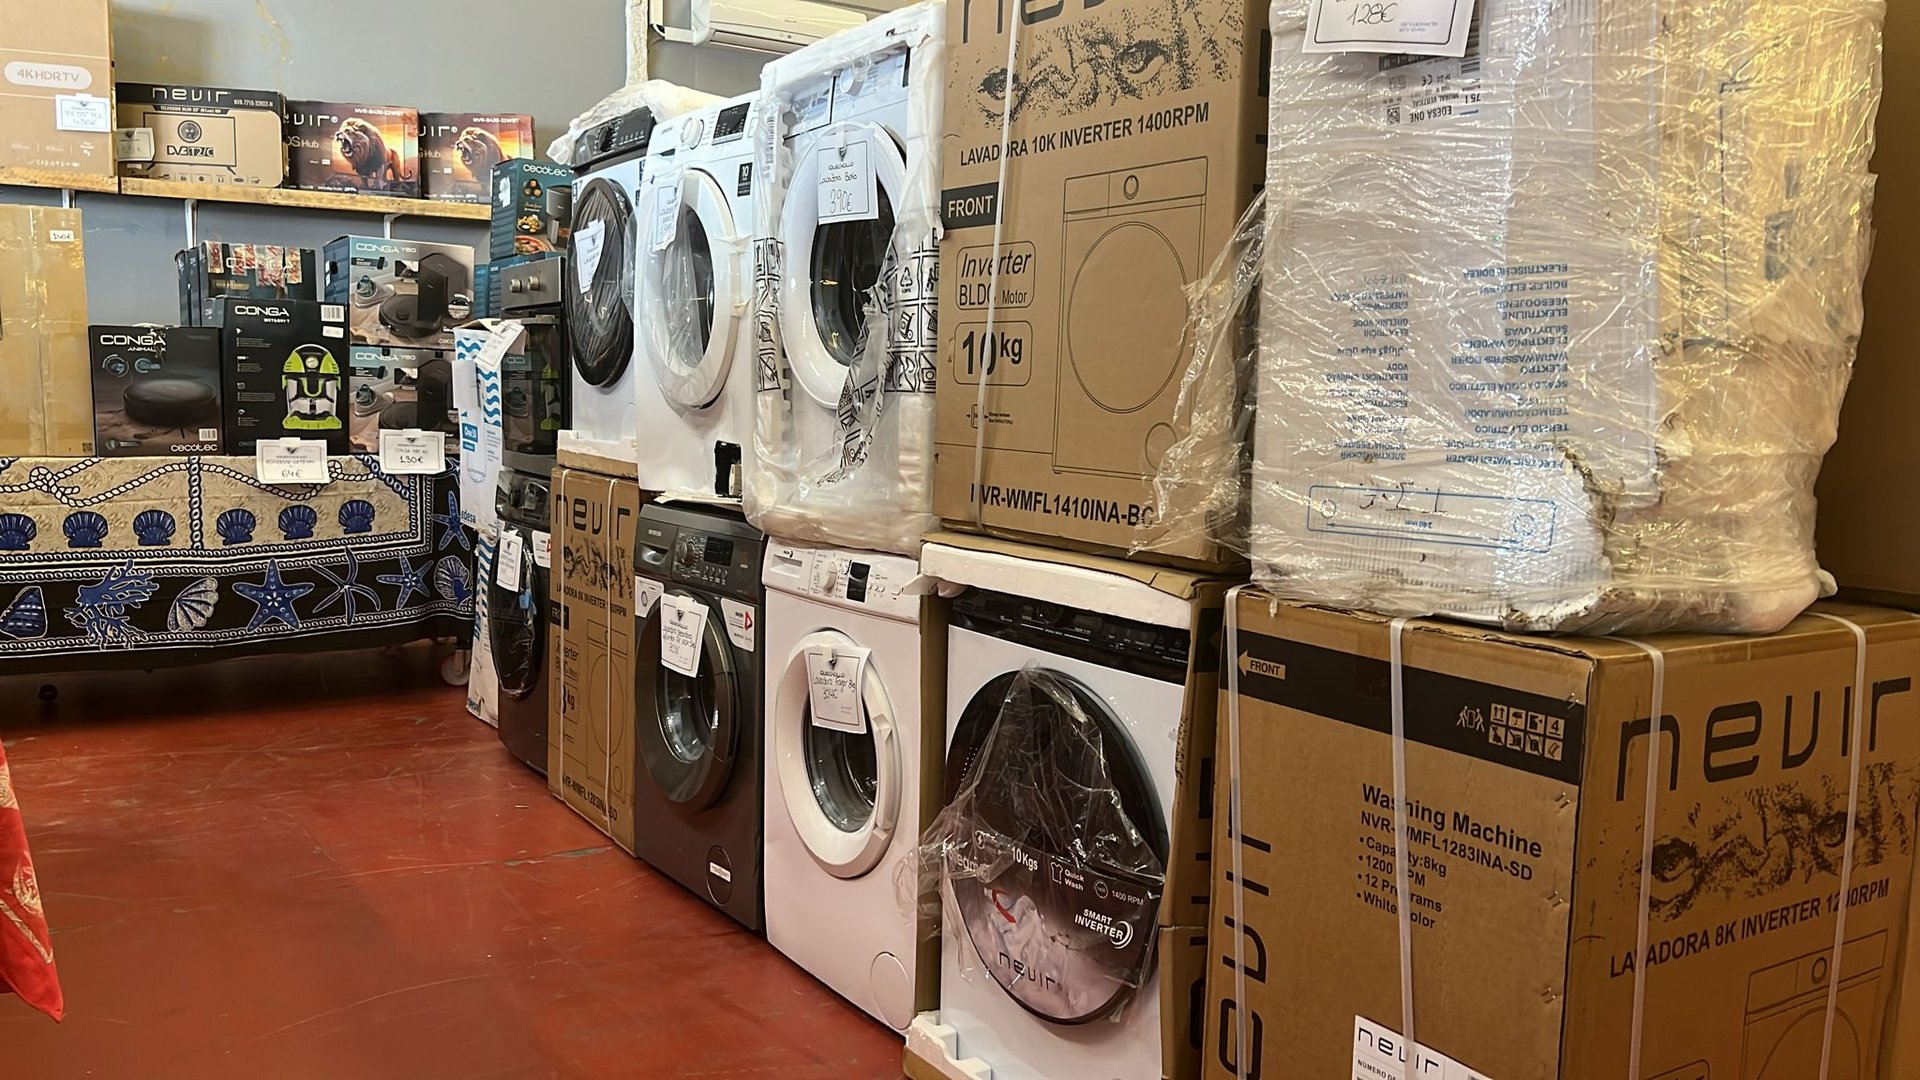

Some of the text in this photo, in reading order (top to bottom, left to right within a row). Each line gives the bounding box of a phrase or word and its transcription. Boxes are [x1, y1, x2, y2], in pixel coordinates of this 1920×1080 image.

[1347, 2, 1398, 26] 128€
[61, 72, 80, 82] TV
[152, 87, 230, 103] nevir
[1409, 105, 1452, 123] EDESA ONE
[1032, 131, 1056, 154] 10K
[1059, 118, 1133, 149] INVERTER
[1137, 102, 1210, 135] 1400RPM
[301, 141, 319, 149] Hub
[522, 163, 567, 177] cecotec
[947, 195, 994, 218] FRONT
[355, 242, 400, 254] CONGA
[1002, 290, 1028, 305] Motor
[234, 305, 290, 317] CONGA
[99, 334, 167, 346] CONGA
[170, 443, 218, 452] cecotec
[555, 493, 631, 541] nevr
[1249, 658, 1281, 677] FRONT
[1615, 676, 1912, 802] nevir
[1452, 811, 1544, 859] Machine
[1361, 810, 1533, 881] NVR-MFL1283INA-SD
[1366, 836, 1448, 878] Capaty:8kg
[1064, 868, 1085, 883] Quick
[1366, 855, 1426, 887] 1200 PM
[1064, 878, 1084, 892] Wash
[1364, 873, 1443, 913] 12 Prorams
[1111, 889, 1144, 907] 1400 RPM
[1083, 908, 1113, 925] SMART
[1363, 890, 1437, 930] White olor
[1074, 914, 1125, 941] INVERTER
[1609, 877, 1891, 980] LAADORA 8K INVERTER 120RPM
[999, 951, 1058, 991] nevir
